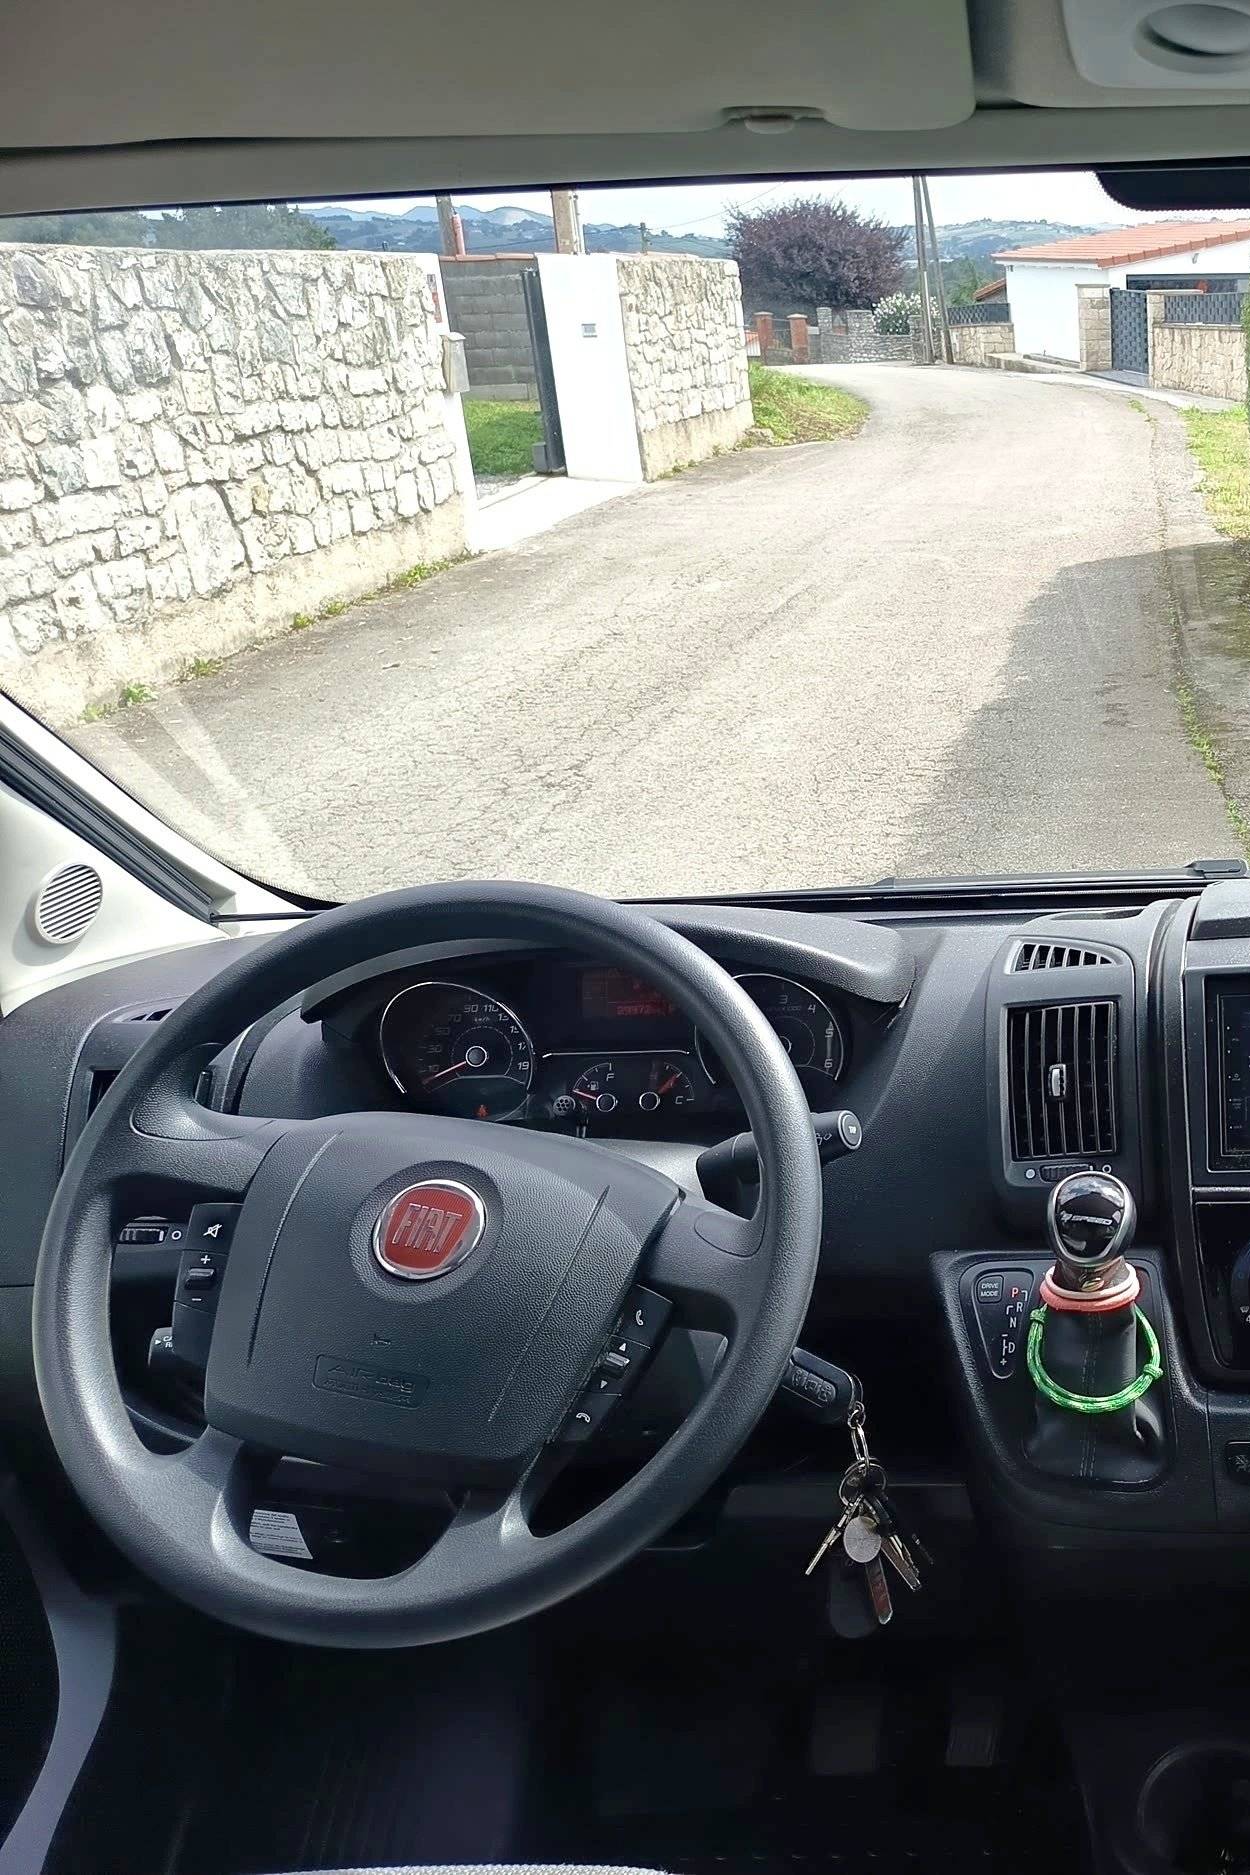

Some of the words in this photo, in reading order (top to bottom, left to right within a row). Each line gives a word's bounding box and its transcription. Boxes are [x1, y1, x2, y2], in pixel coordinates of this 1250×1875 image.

[808, 1004, 816, 1013] 4
[824, 1058, 833, 1068] 6
[606, 1072, 615, 1081] F
[675, 1096, 683, 1105] C
[391, 1203, 463, 1253] FIAT
[1011, 1287, 1019, 1298] P
[1016, 1301, 1023, 1312] R
[1009, 1316, 1017, 1328] N
[1008, 1342, 1015, 1353] D
